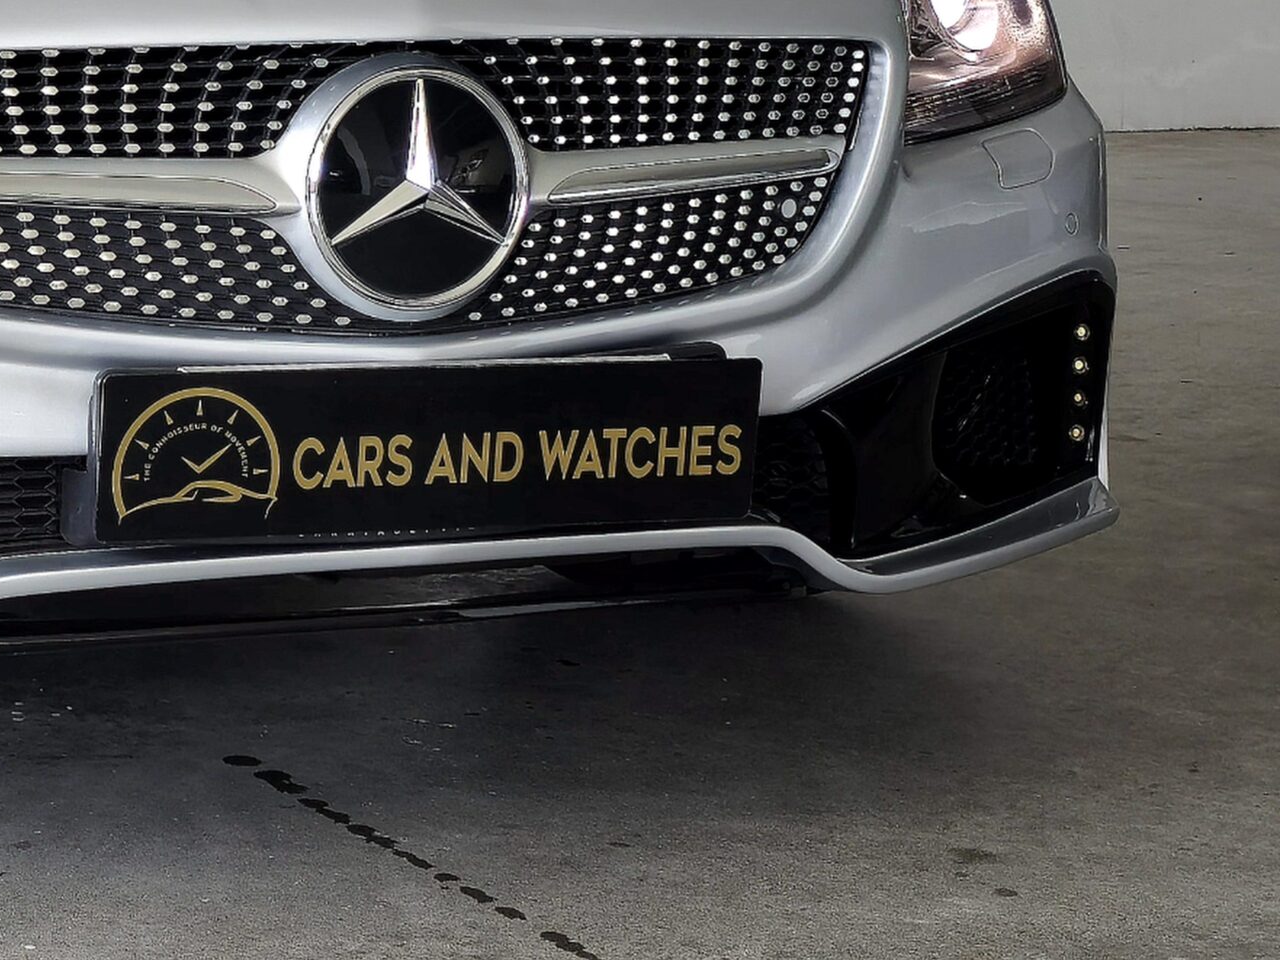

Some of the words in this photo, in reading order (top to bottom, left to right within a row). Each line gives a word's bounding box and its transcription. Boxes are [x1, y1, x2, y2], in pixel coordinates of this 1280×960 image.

[143, 463, 152, 482] THE
[148, 422, 208, 460] CONNOISSEUR
[210, 424, 224, 433] OF
[224, 430, 249, 478] MOVEMENT
[292, 434, 413, 490] CARS
[424, 431, 524, 485] AND
[539, 424, 742, 480] WATCHES
